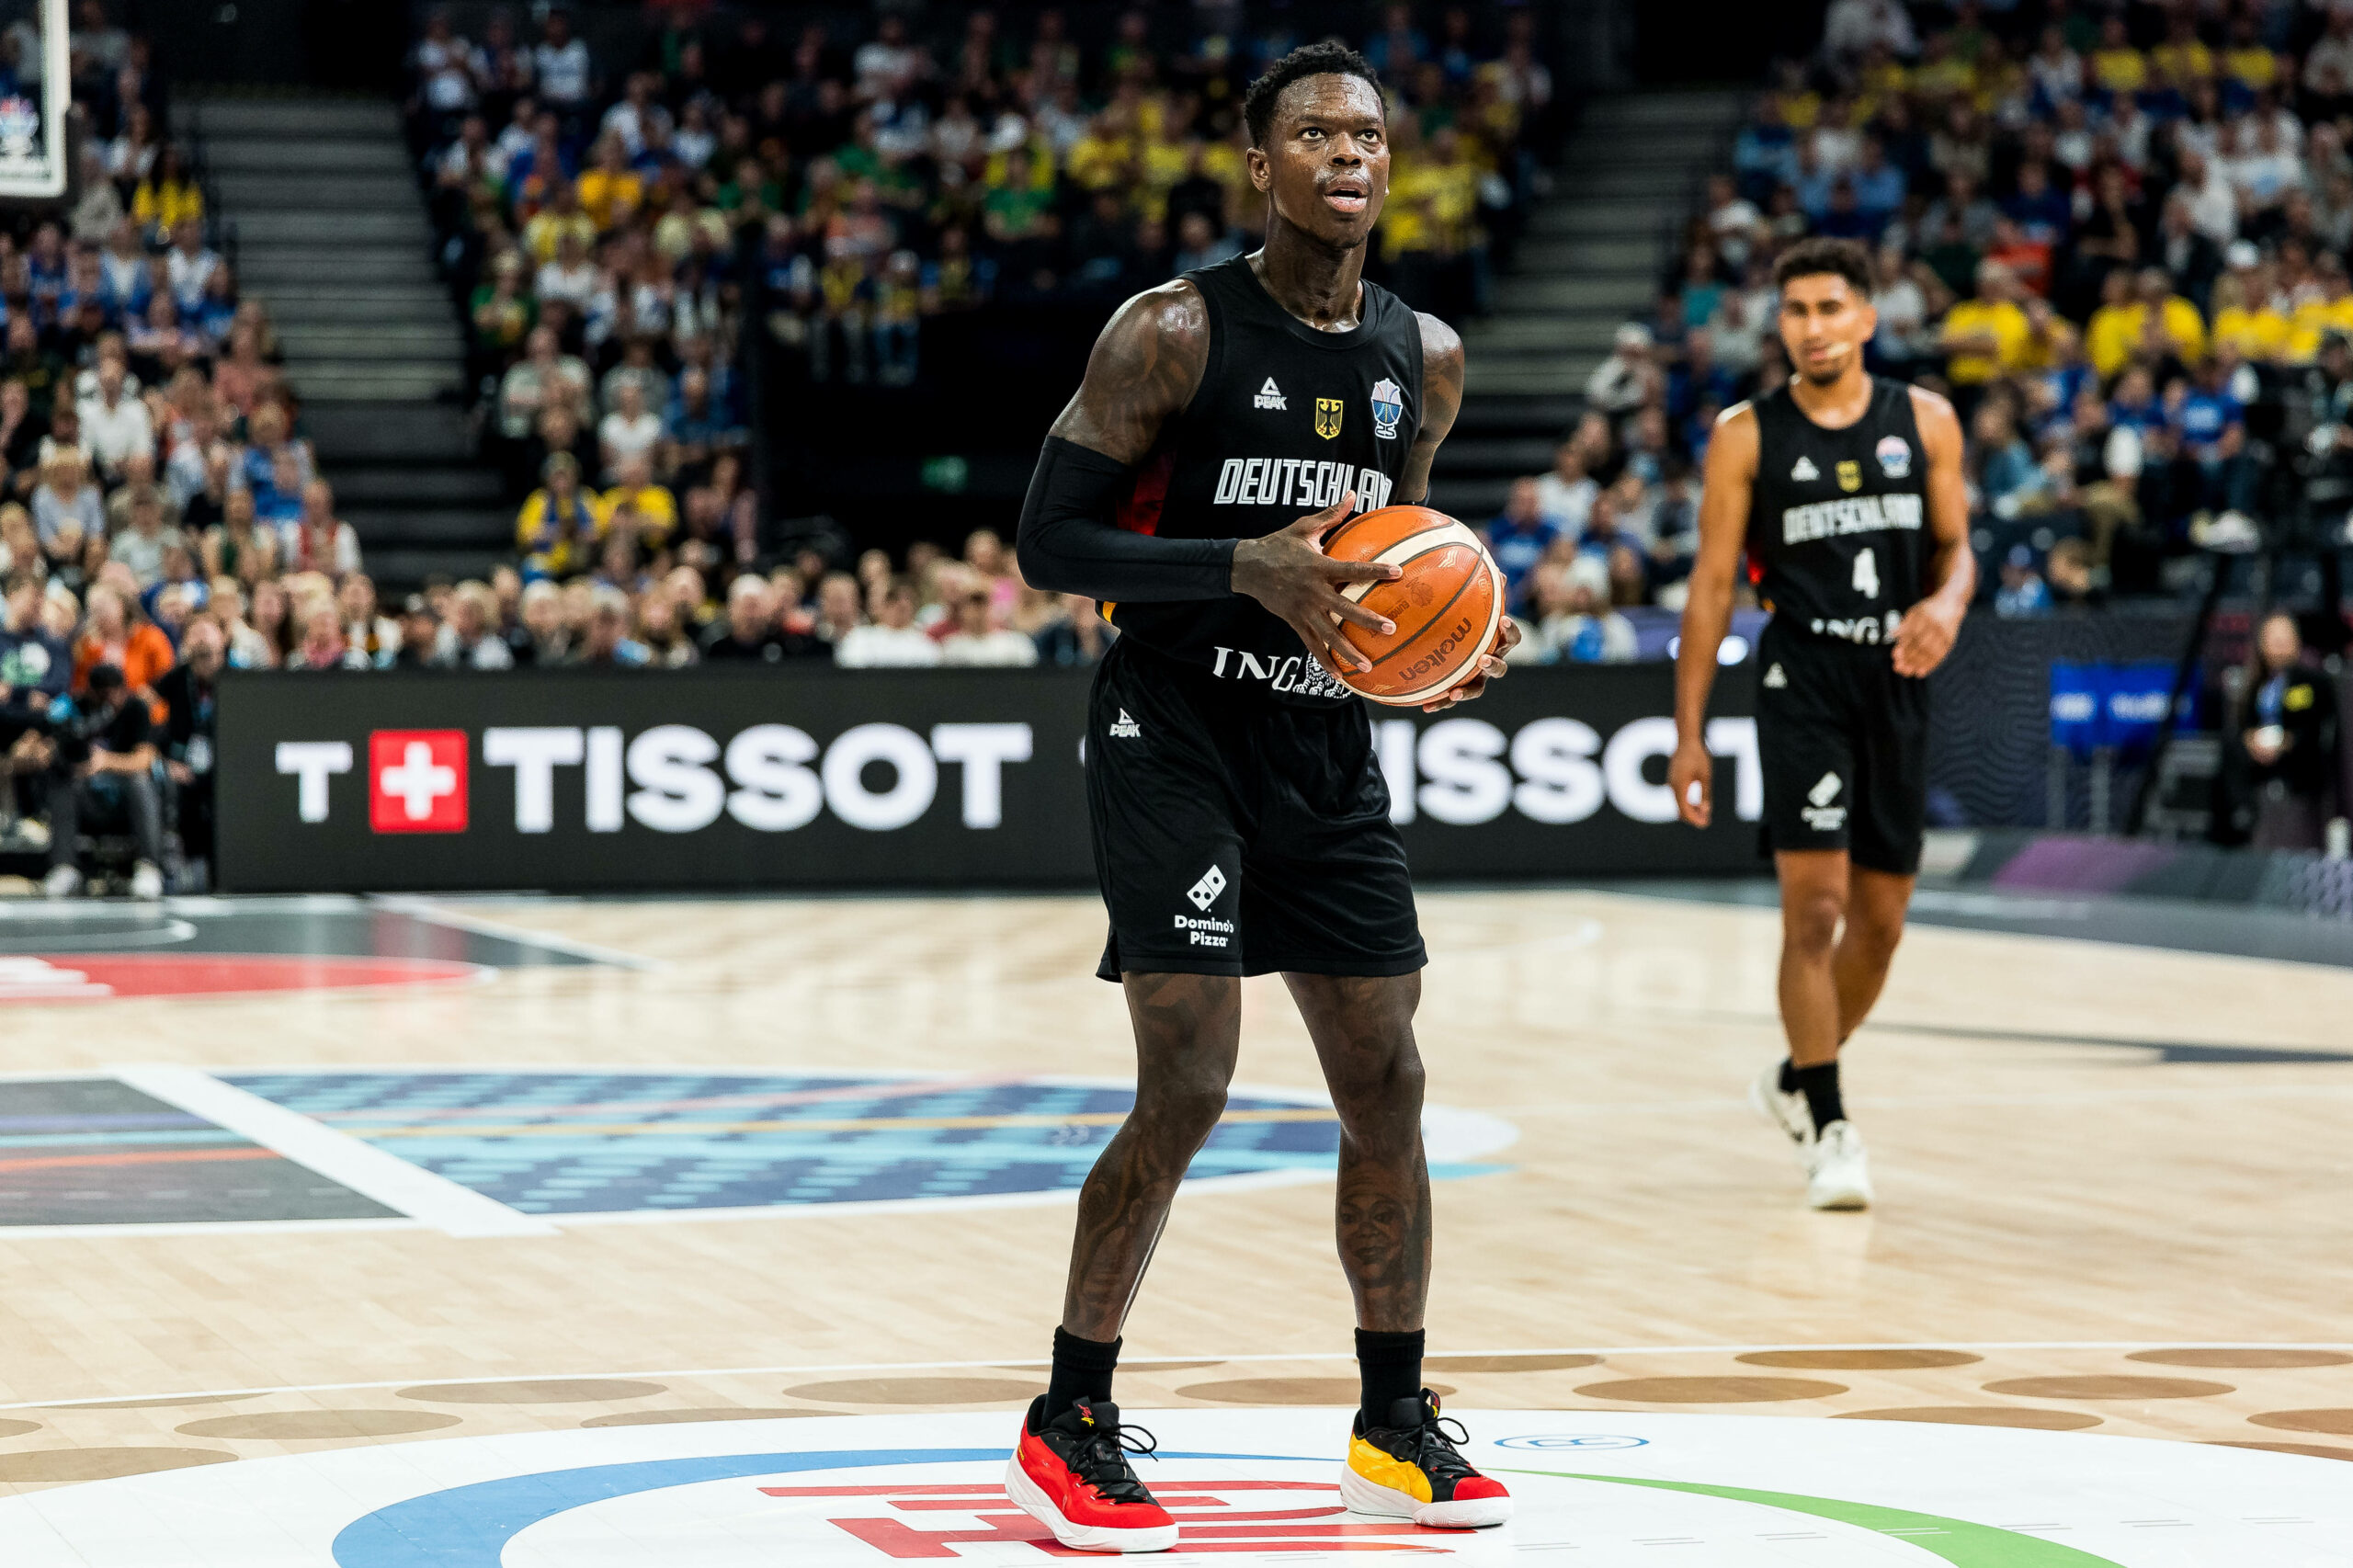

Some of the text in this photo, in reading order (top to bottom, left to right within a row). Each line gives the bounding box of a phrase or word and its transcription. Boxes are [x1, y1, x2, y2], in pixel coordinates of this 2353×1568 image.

[1254, 394, 1287, 411] PEAK
[1851, 548, 1881, 599] 4
[1212, 646, 1302, 692] ING
[1399, 616, 1472, 682] molten
[1109, 723, 1141, 738] PEAK
[276, 722, 1033, 834] T TISSOT
[1370, 715, 1764, 825] ISSOT
[1174, 915, 1234, 934] Domino's
[1189, 930, 1228, 948] Pizza
